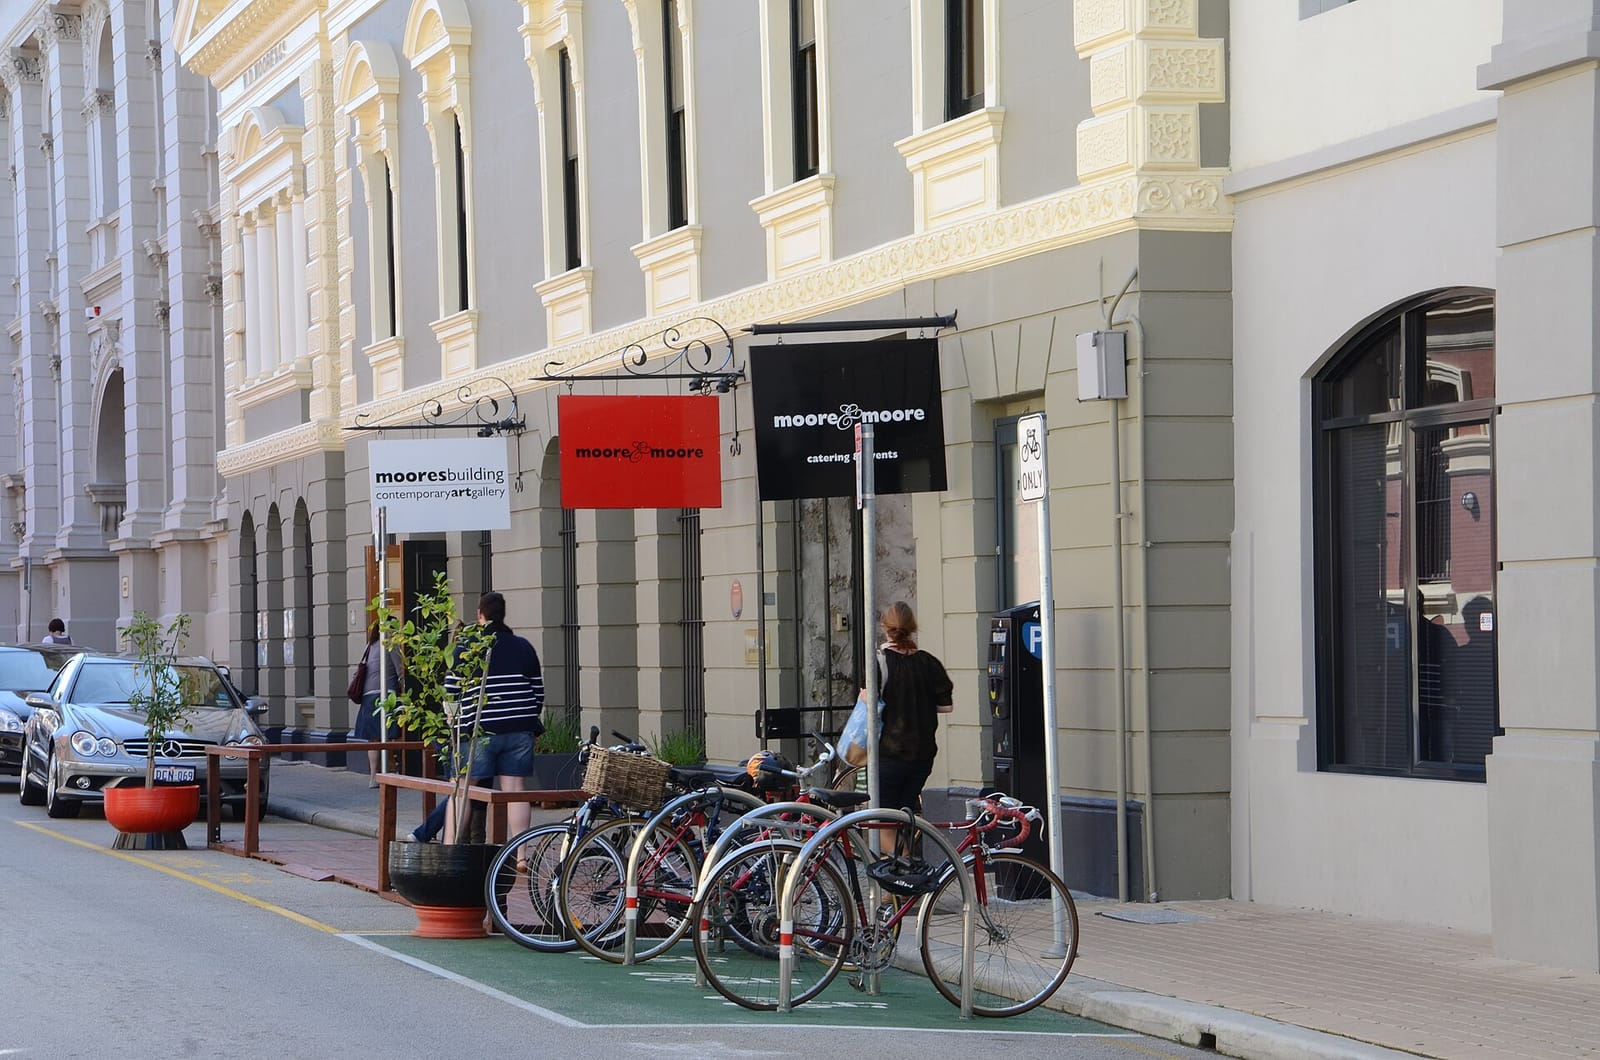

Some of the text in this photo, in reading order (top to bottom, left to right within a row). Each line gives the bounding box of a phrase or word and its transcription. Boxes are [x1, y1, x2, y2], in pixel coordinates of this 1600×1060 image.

[806, 451, 850, 464] catering
[872, 450, 899, 460] ents
[1022, 470, 1043, 490] ONLY
[1033, 610, 1039, 618] 4
[1030, 626, 1042, 653] P
